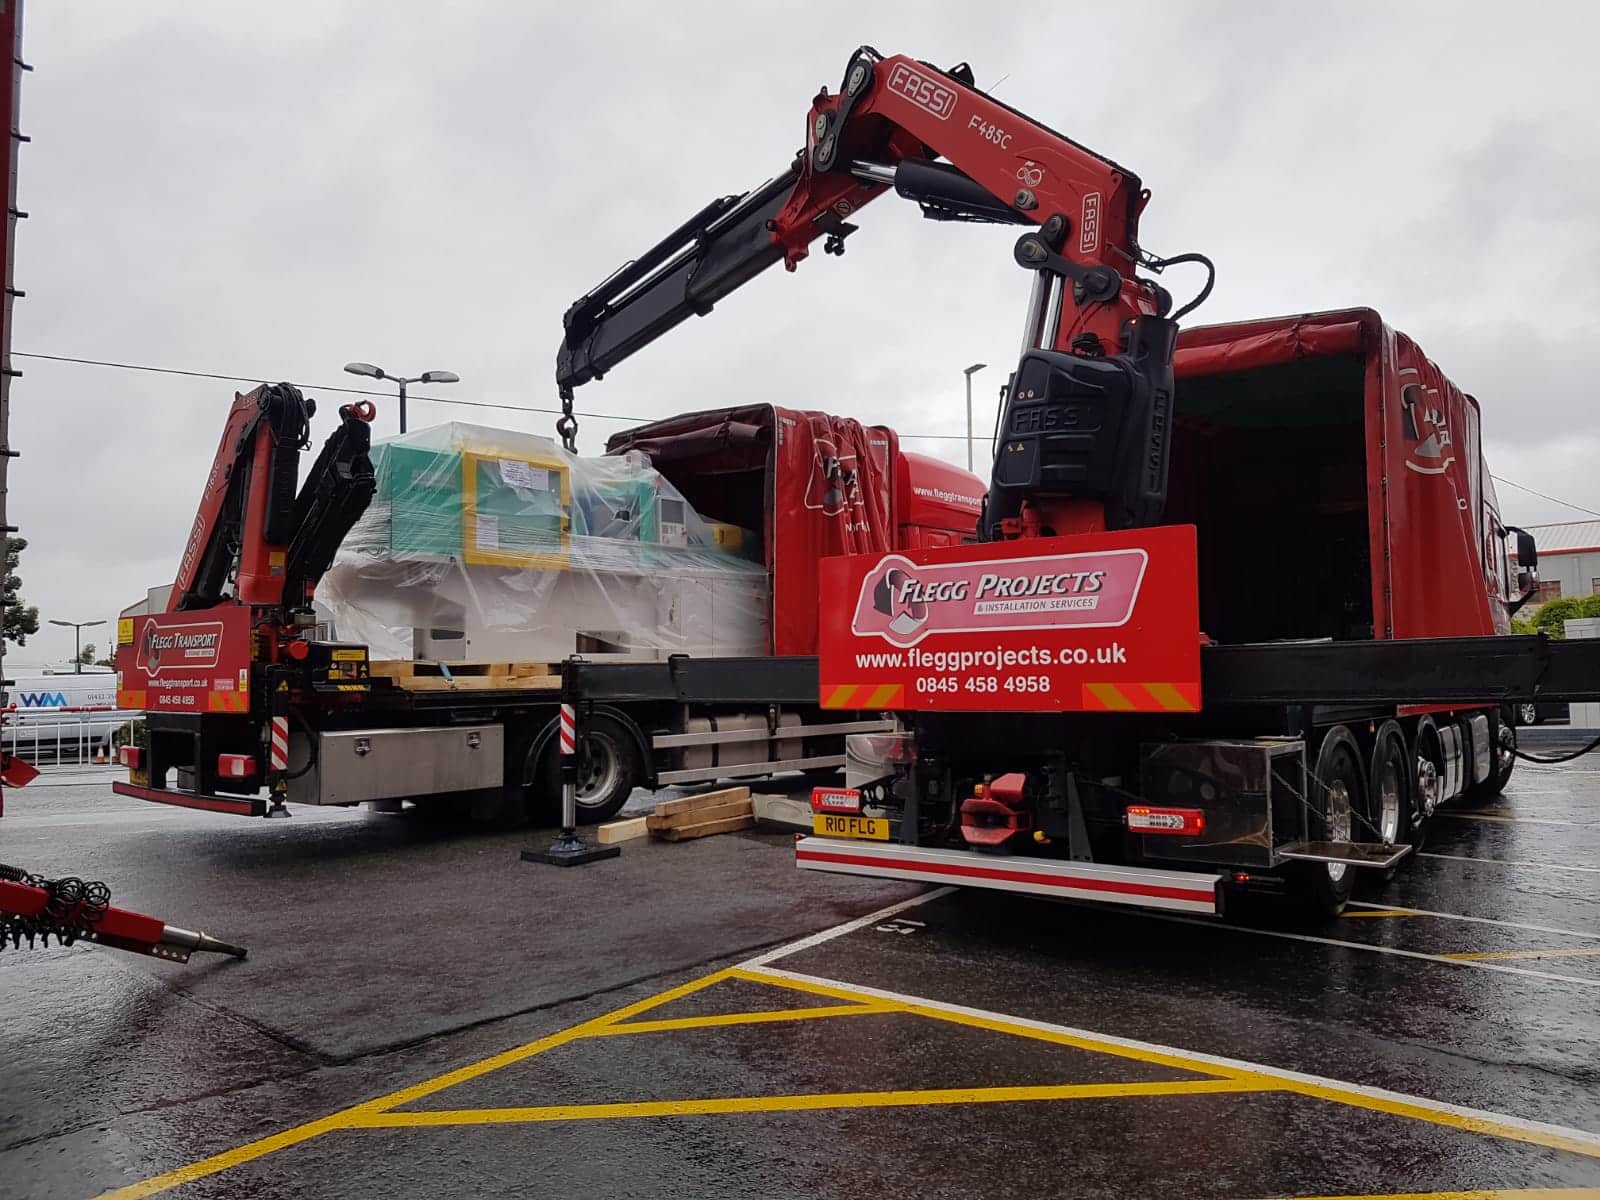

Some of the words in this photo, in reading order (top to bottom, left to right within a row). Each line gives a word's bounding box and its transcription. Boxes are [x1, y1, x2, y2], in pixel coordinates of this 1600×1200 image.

[891, 67, 952, 114] FASSI
[968, 114, 1012, 150] F485C
[1083, 197, 1097, 248] FASSI
[178, 516, 206, 589] FASSI
[899, 579, 970, 603] FLEGG
[975, 571, 1104, 599] PROJECTS
[985, 602, 1046, 612] INSTALLATION
[1050, 598, 1093, 609] SERVICES
[174, 633, 218, 648] TRANSPORT
[856, 642, 1127, 671] www.fleggprojects.co.uk
[916, 677, 958, 692] 0845
[965, 676, 998, 692] 458
[1004, 676, 1050, 692] 4958
[850, 819, 876, 834] FLG
